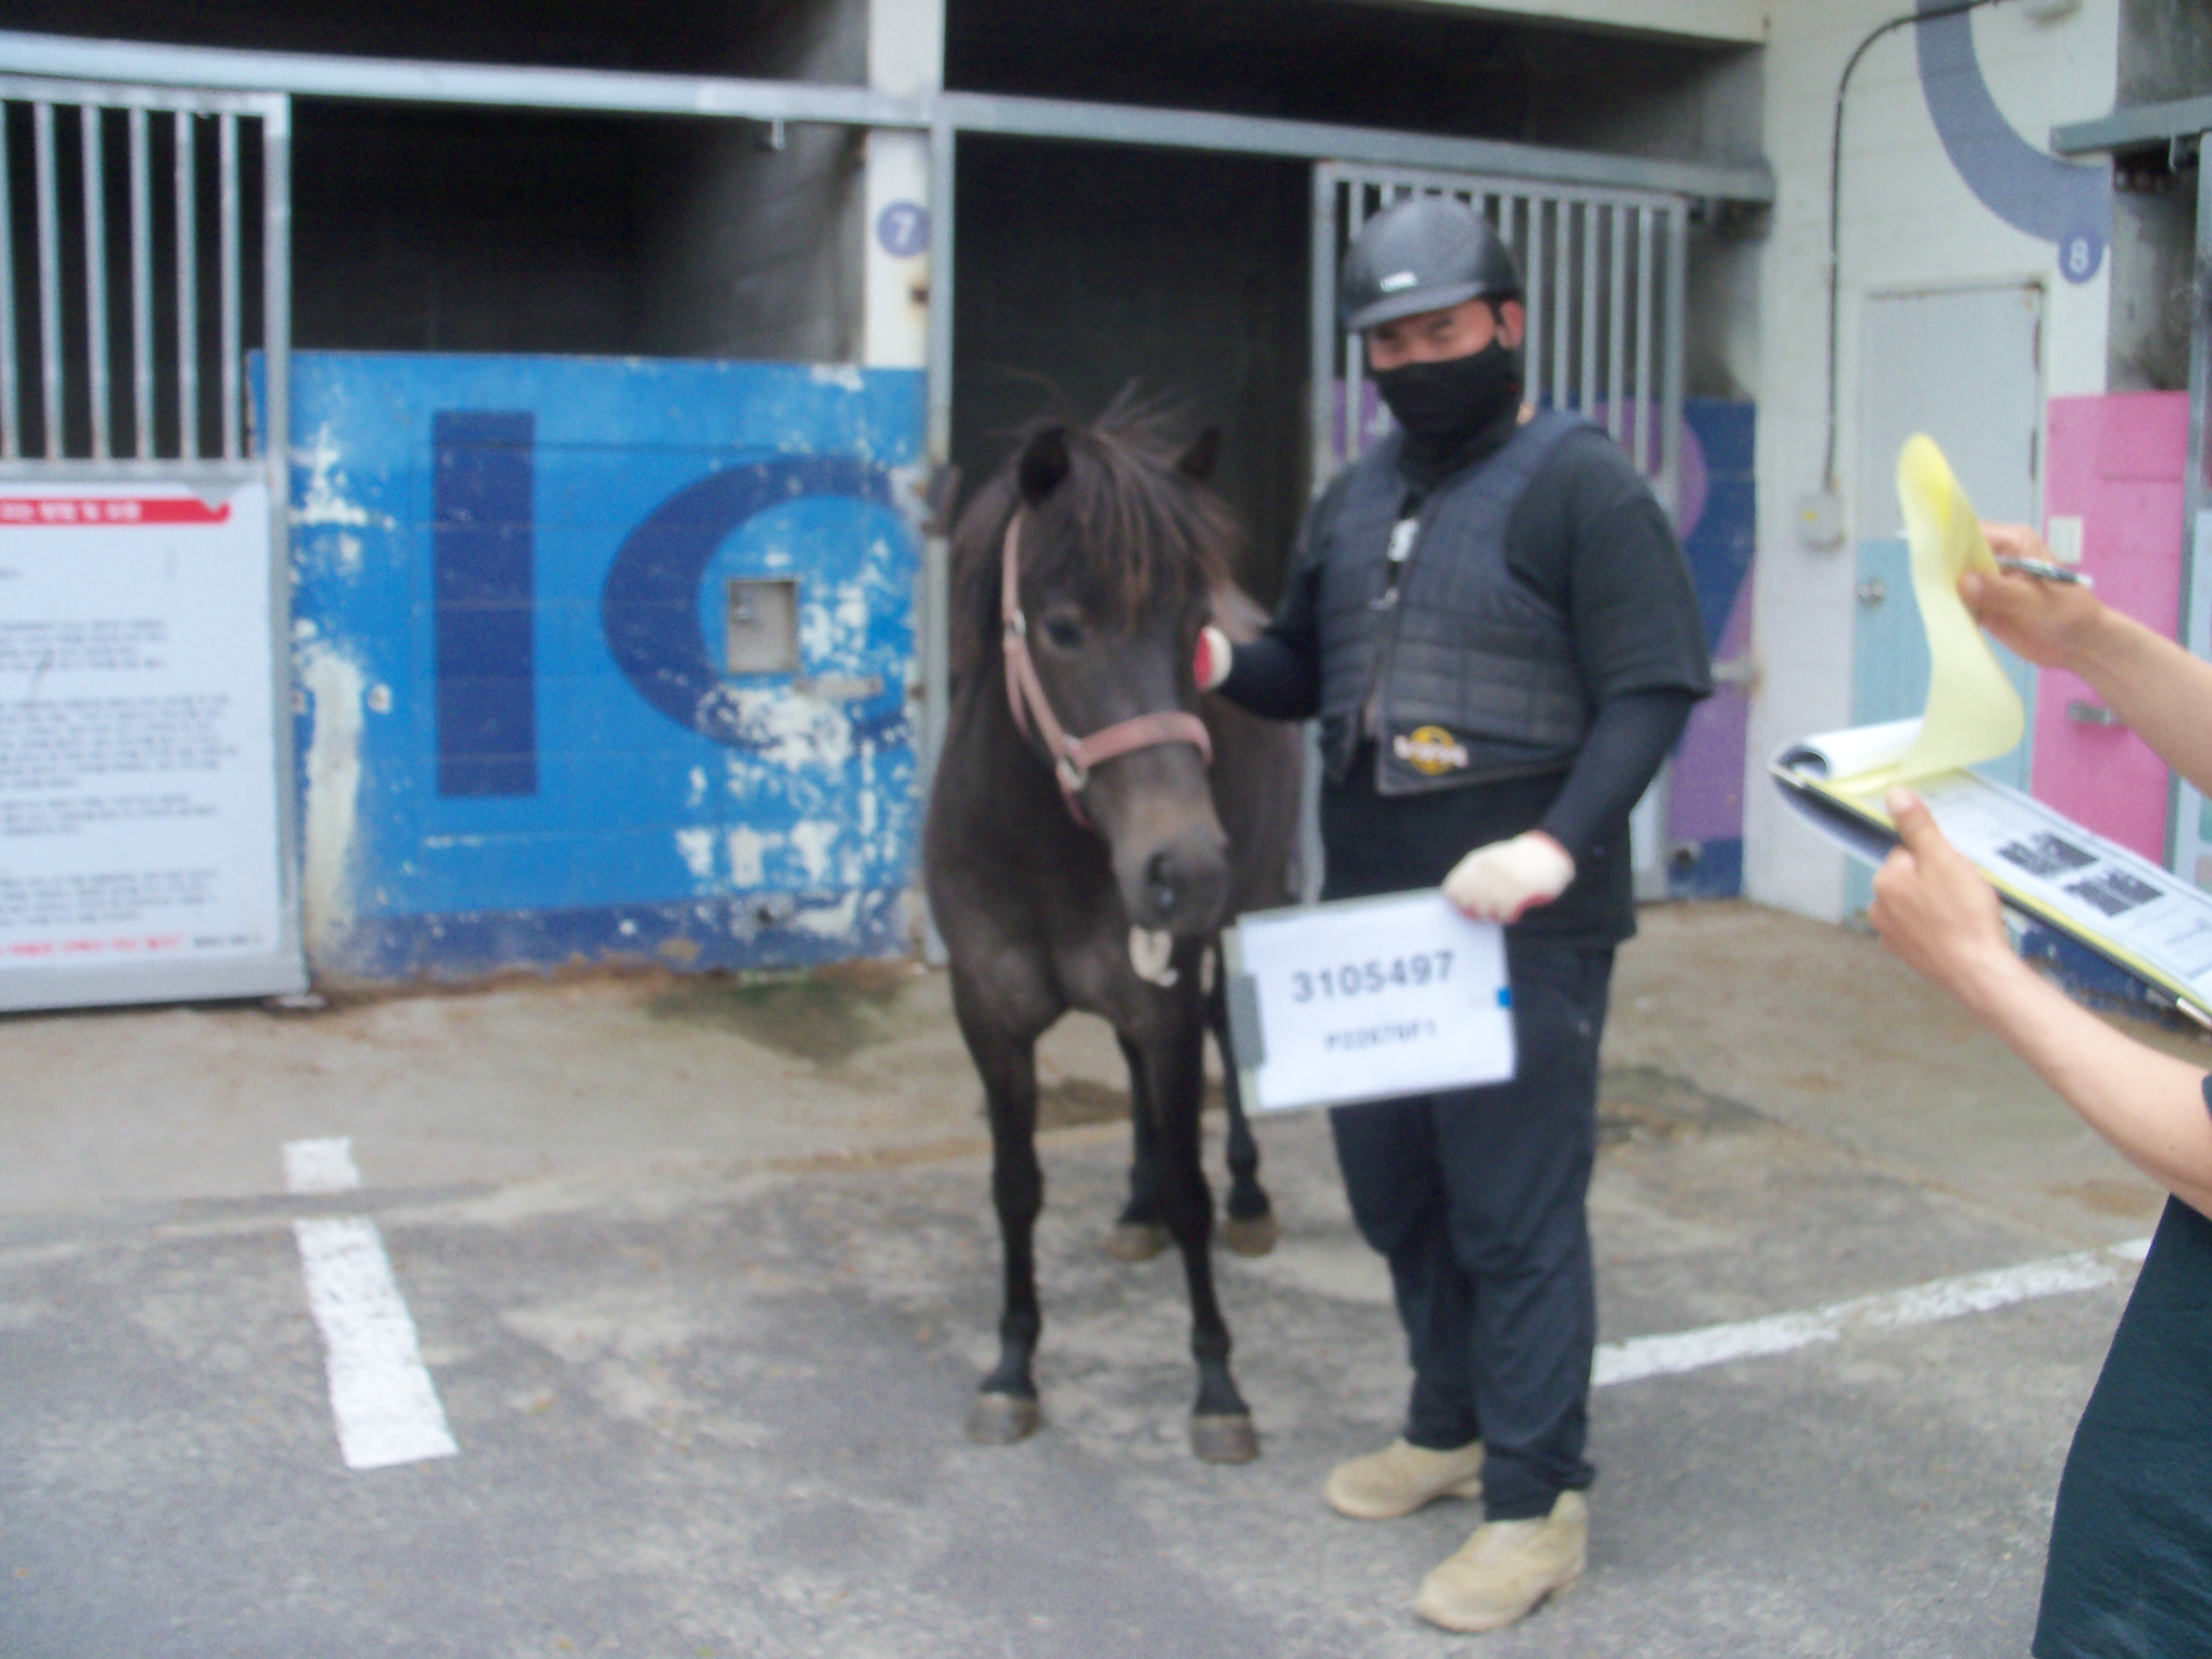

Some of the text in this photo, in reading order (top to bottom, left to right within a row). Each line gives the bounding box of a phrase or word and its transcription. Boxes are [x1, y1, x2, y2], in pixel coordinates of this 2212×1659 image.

[892, 211, 915, 246] 7
[2069, 237, 2089, 274] 8
[1290, 950, 1454, 1003] 3105497
